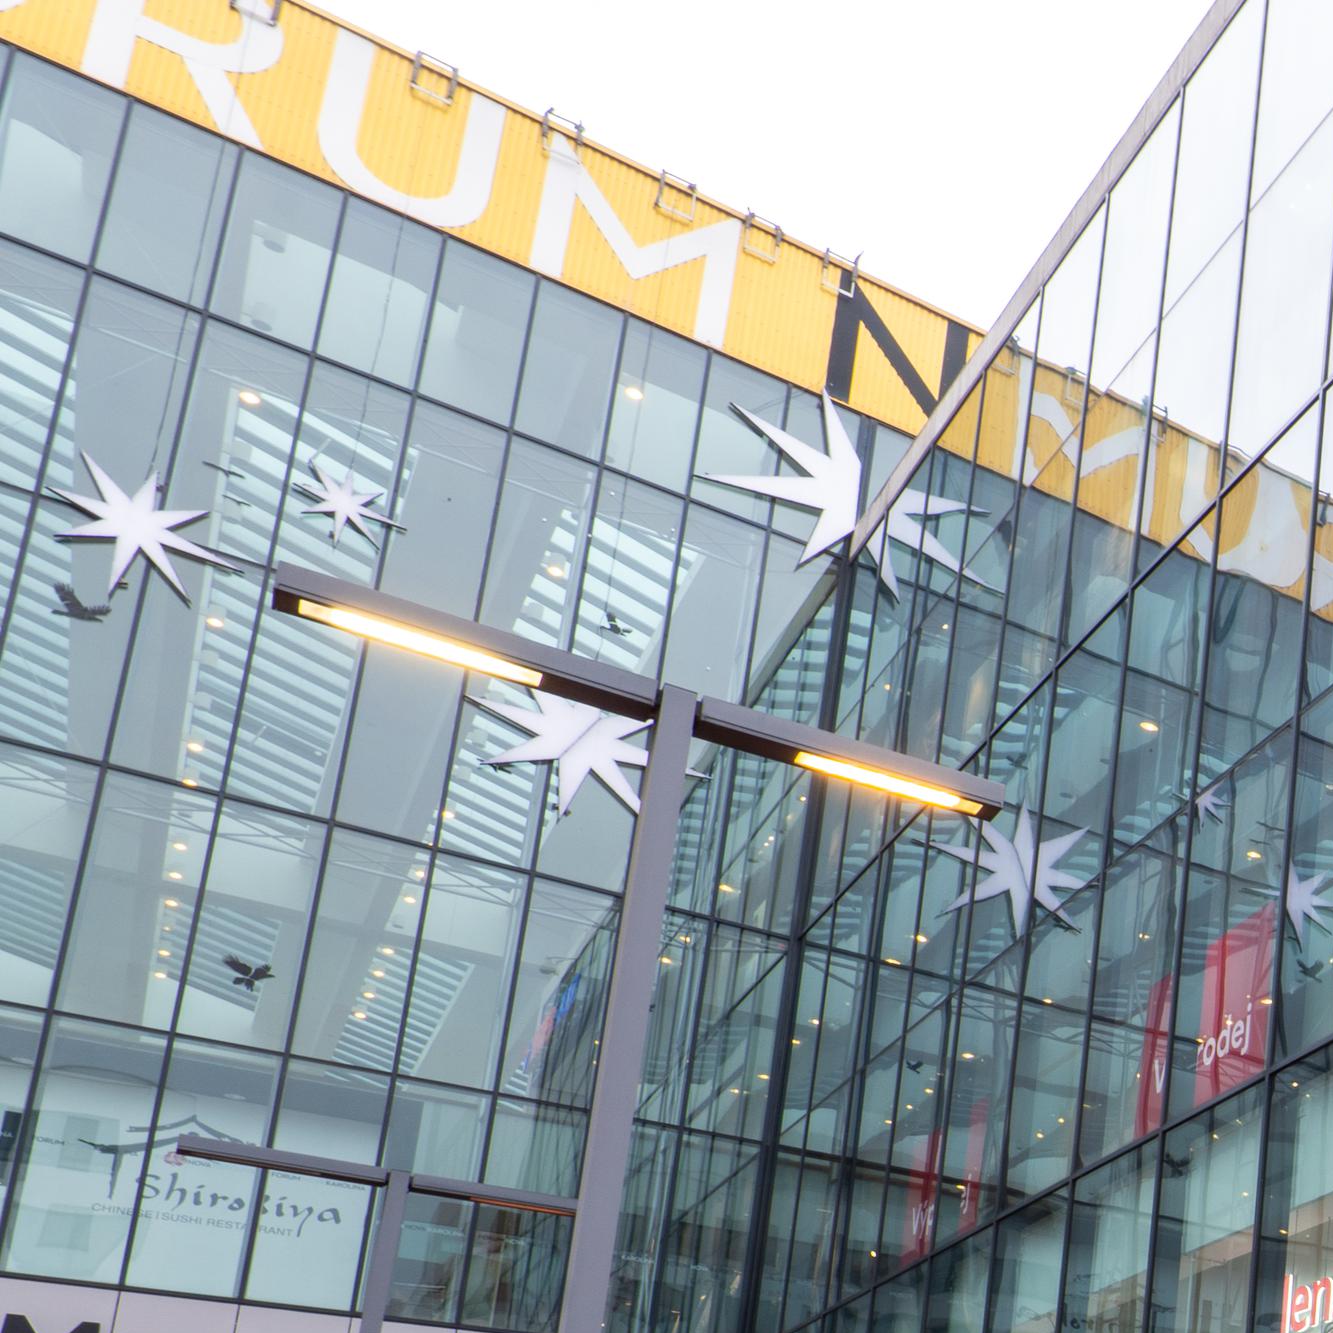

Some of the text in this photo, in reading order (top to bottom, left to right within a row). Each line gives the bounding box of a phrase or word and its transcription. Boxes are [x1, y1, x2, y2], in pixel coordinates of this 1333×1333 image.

[0, 0, 741, 348] RUM
[162, 1212, 202, 1226] SUSHI
[207, 1217, 294, 1237] RESTARANT
